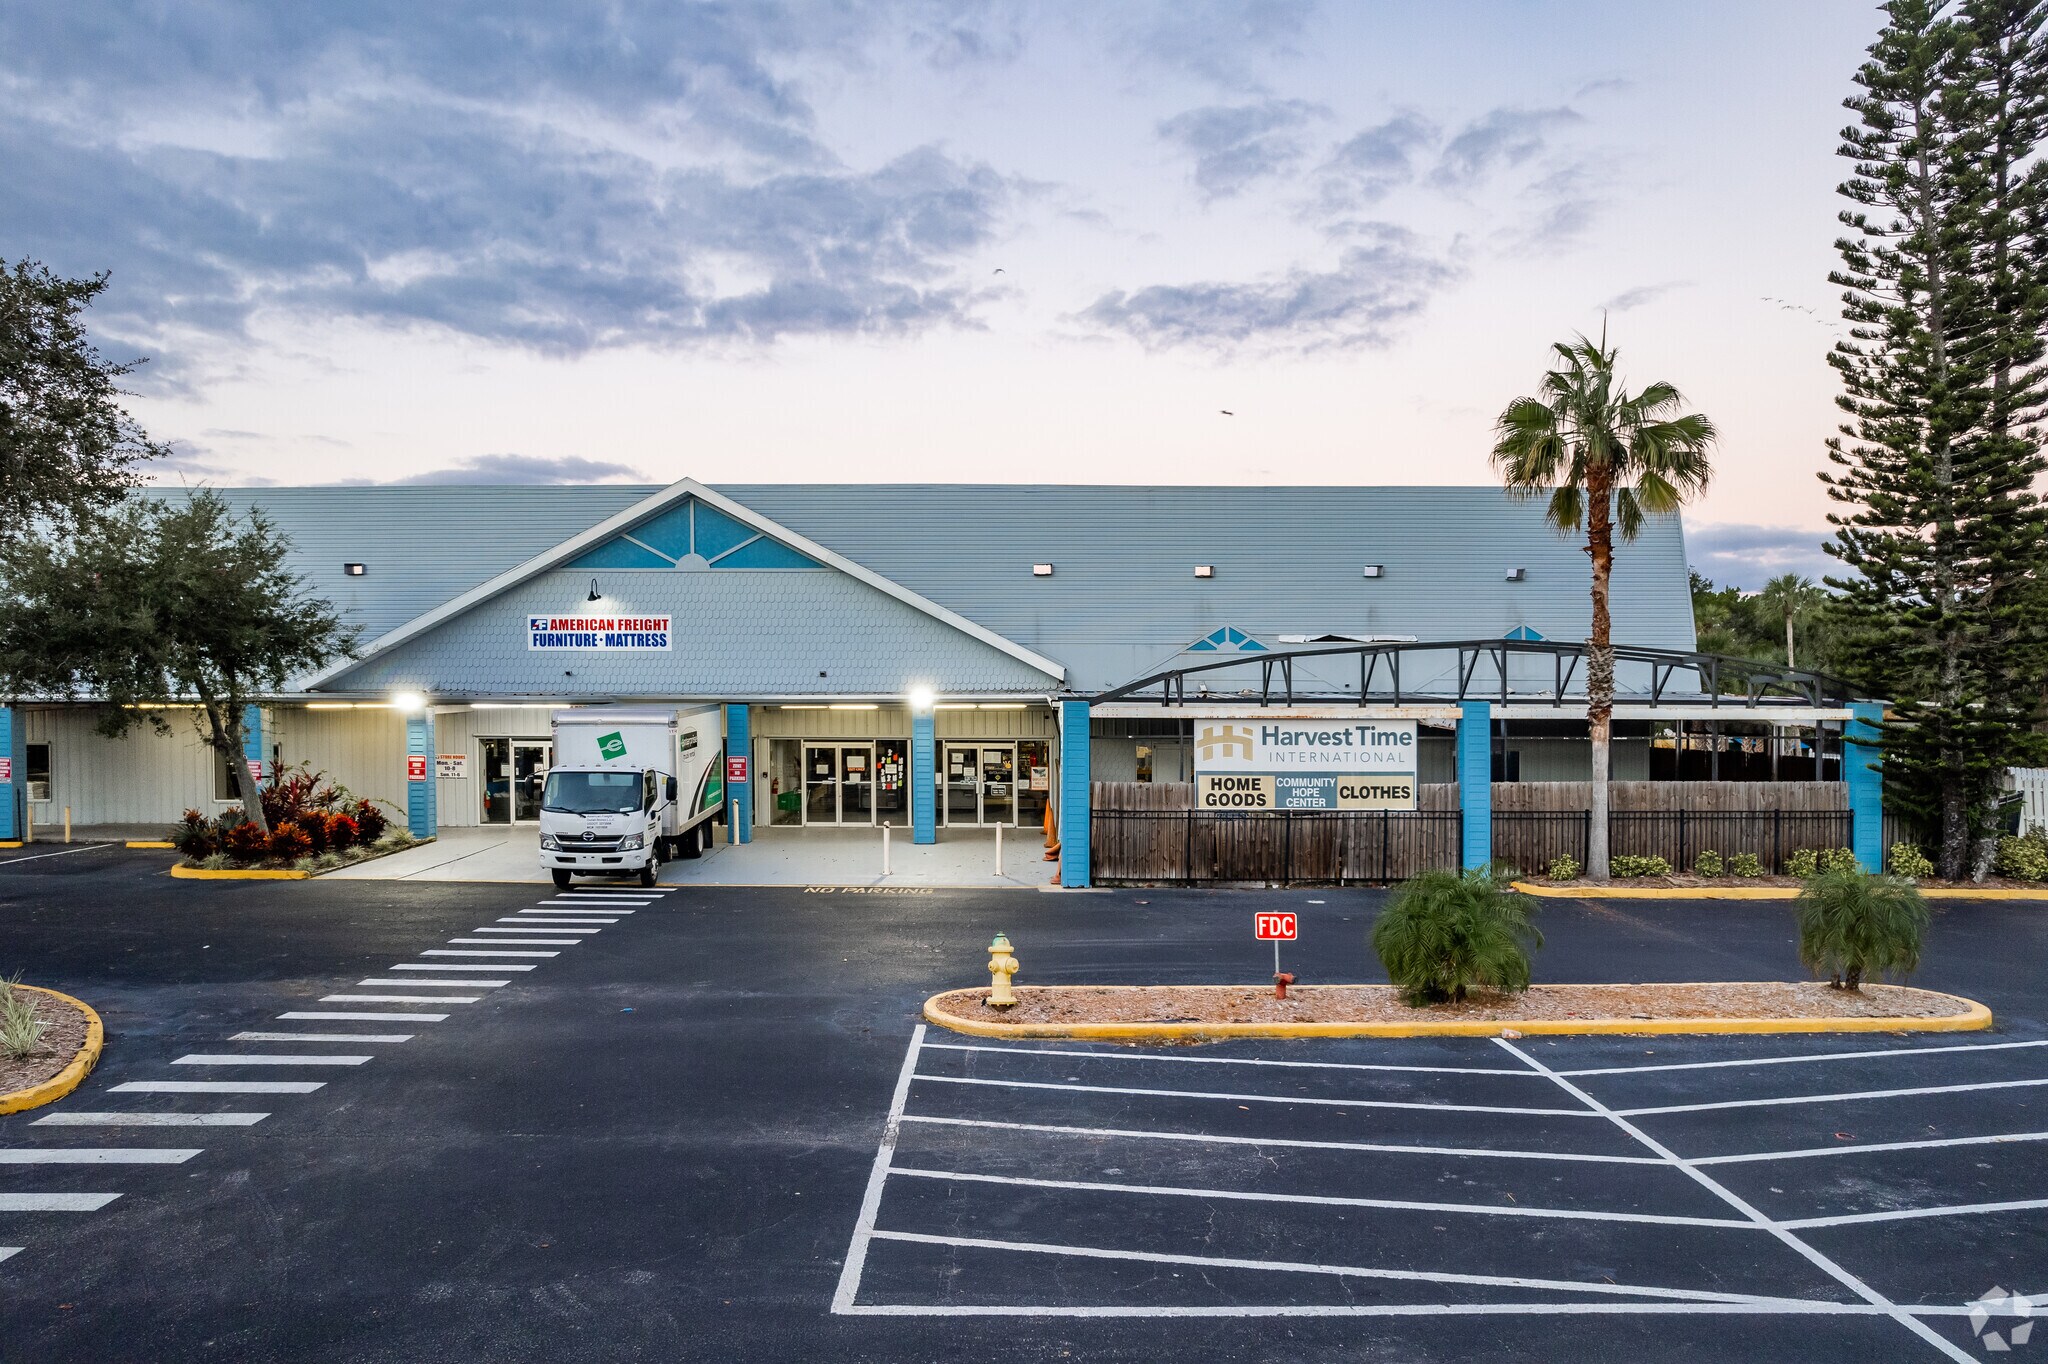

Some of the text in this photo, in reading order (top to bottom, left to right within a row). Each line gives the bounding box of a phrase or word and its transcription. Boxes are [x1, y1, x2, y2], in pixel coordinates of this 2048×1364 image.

[550, 619, 614, 631] AMERICAN
[618, 619, 669, 631] FREIGHT
[533, 633, 667, 647] FURNITURE MATTRESS
[1261, 725, 1413, 746] Harvest Time
[1269, 751, 1405, 763] INTERNATIONAL
[1210, 777, 1261, 791] HOME
[1276, 777, 1336, 787] COMMUNITY
[1292, 788, 1320, 797] HOPE
[1339, 786, 1411, 800] CLOTHES
[1205, 793, 1267, 807] GOODS
[1286, 798, 1326, 808] CENTER
[841, 887, 934, 895] PARKING
[1258, 916, 1294, 936] FDC
